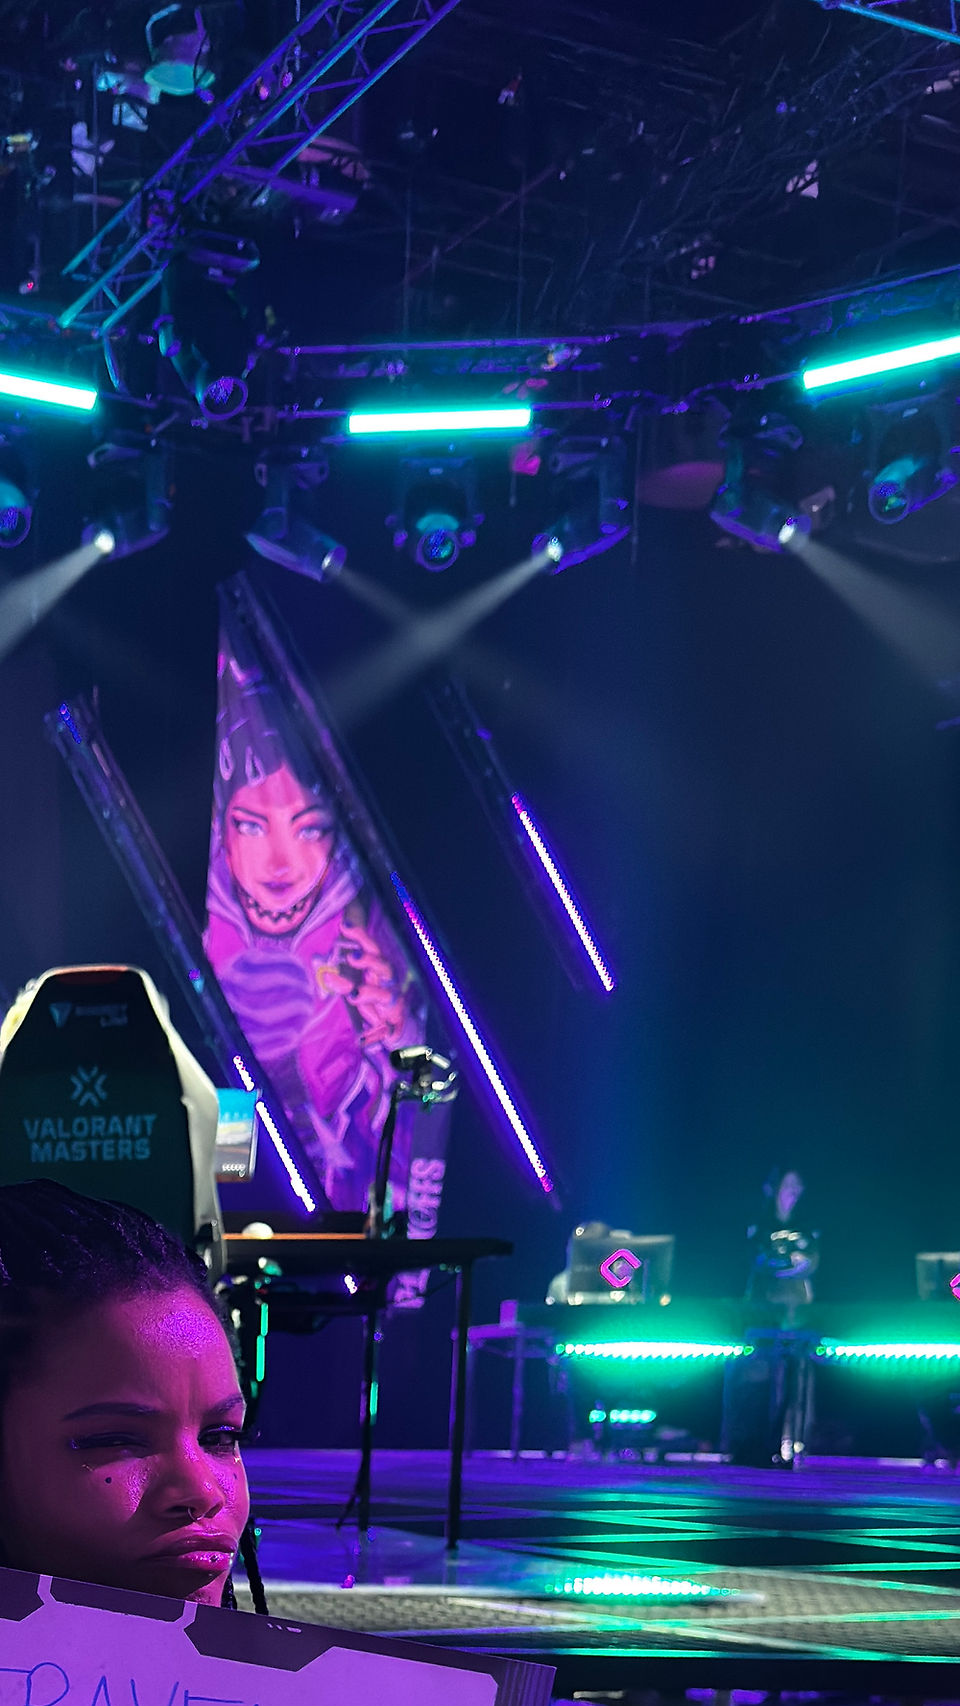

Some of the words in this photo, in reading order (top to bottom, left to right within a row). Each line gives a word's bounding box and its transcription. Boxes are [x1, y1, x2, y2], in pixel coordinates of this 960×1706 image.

[24, 1115, 157, 1137] VALORANT
[31, 1140, 151, 1161] MASTERS
[395, 1159, 445, 1309] PLOFFS
